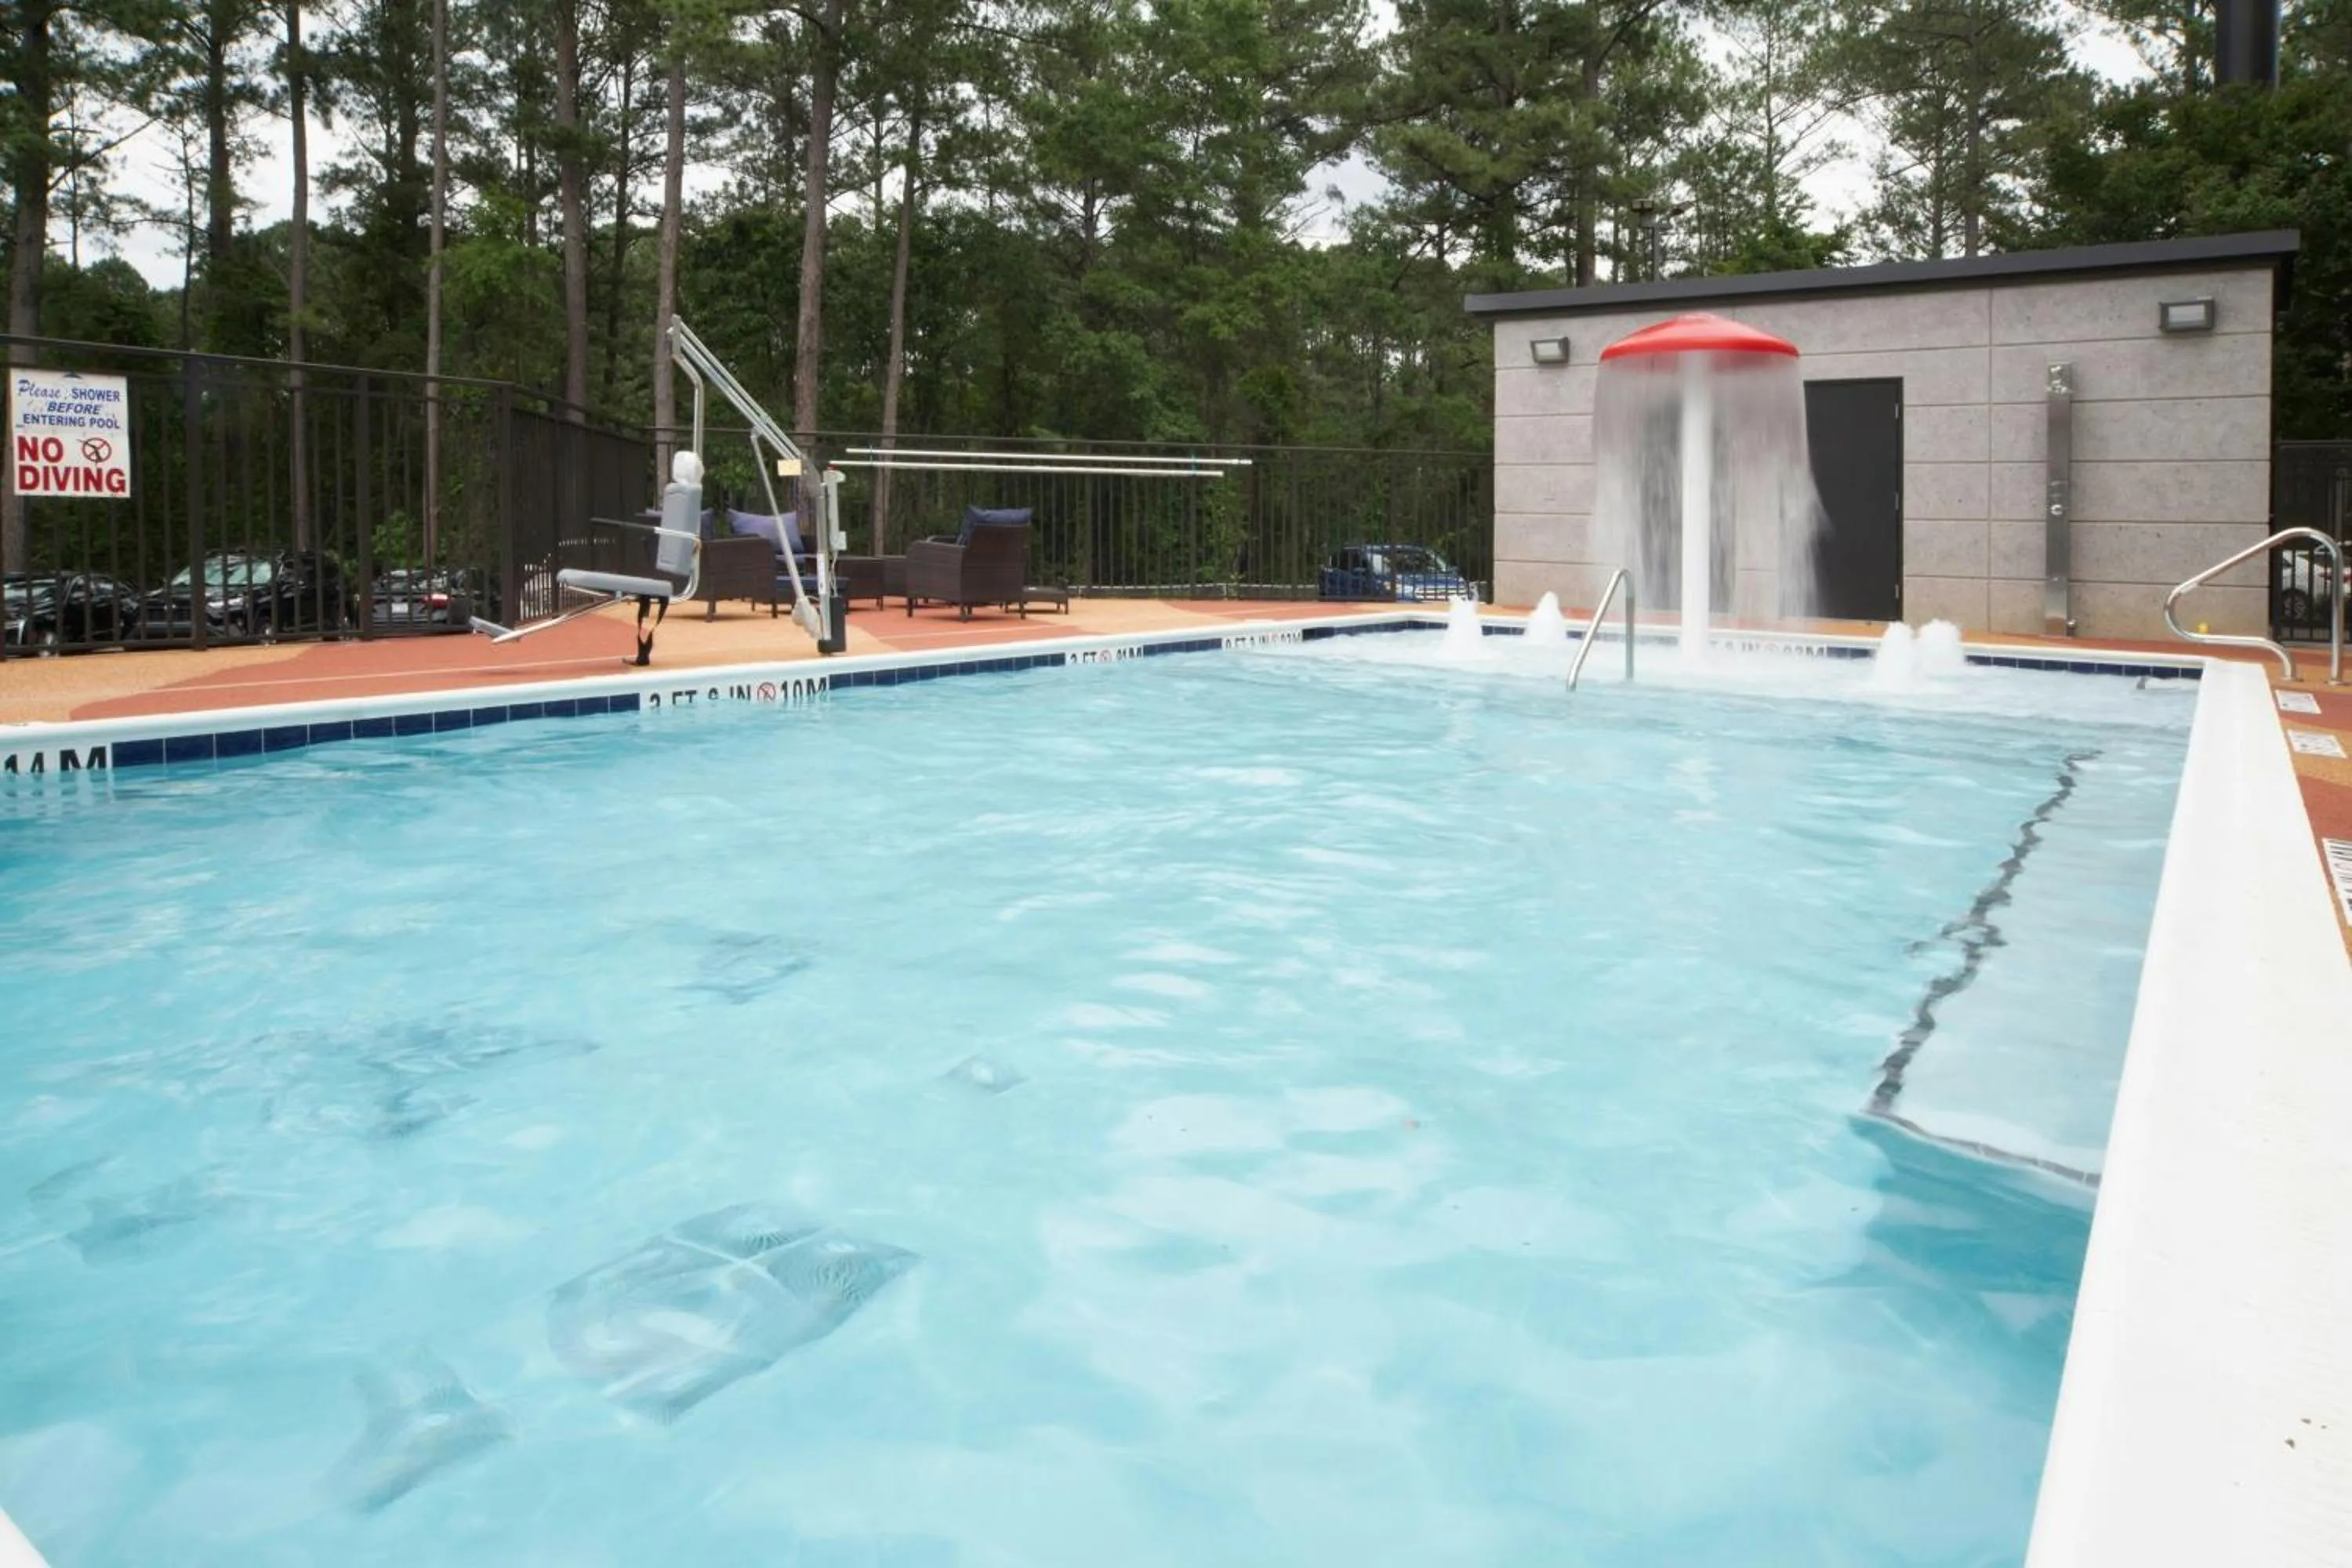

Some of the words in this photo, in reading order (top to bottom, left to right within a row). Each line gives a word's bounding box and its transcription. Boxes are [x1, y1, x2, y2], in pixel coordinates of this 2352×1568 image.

[18, 379, 61, 398] Please
[71, 387, 120, 401] SHOWER
[47, 401, 103, 415] BEFORE
[24, 413, 85, 427] ENTERING
[89, 417, 120, 429] POOL
[17, 436, 64, 463] NO
[19, 465, 126, 493] DIVING
[672, 689, 697, 705] FT
[729, 684, 751, 702] IN
